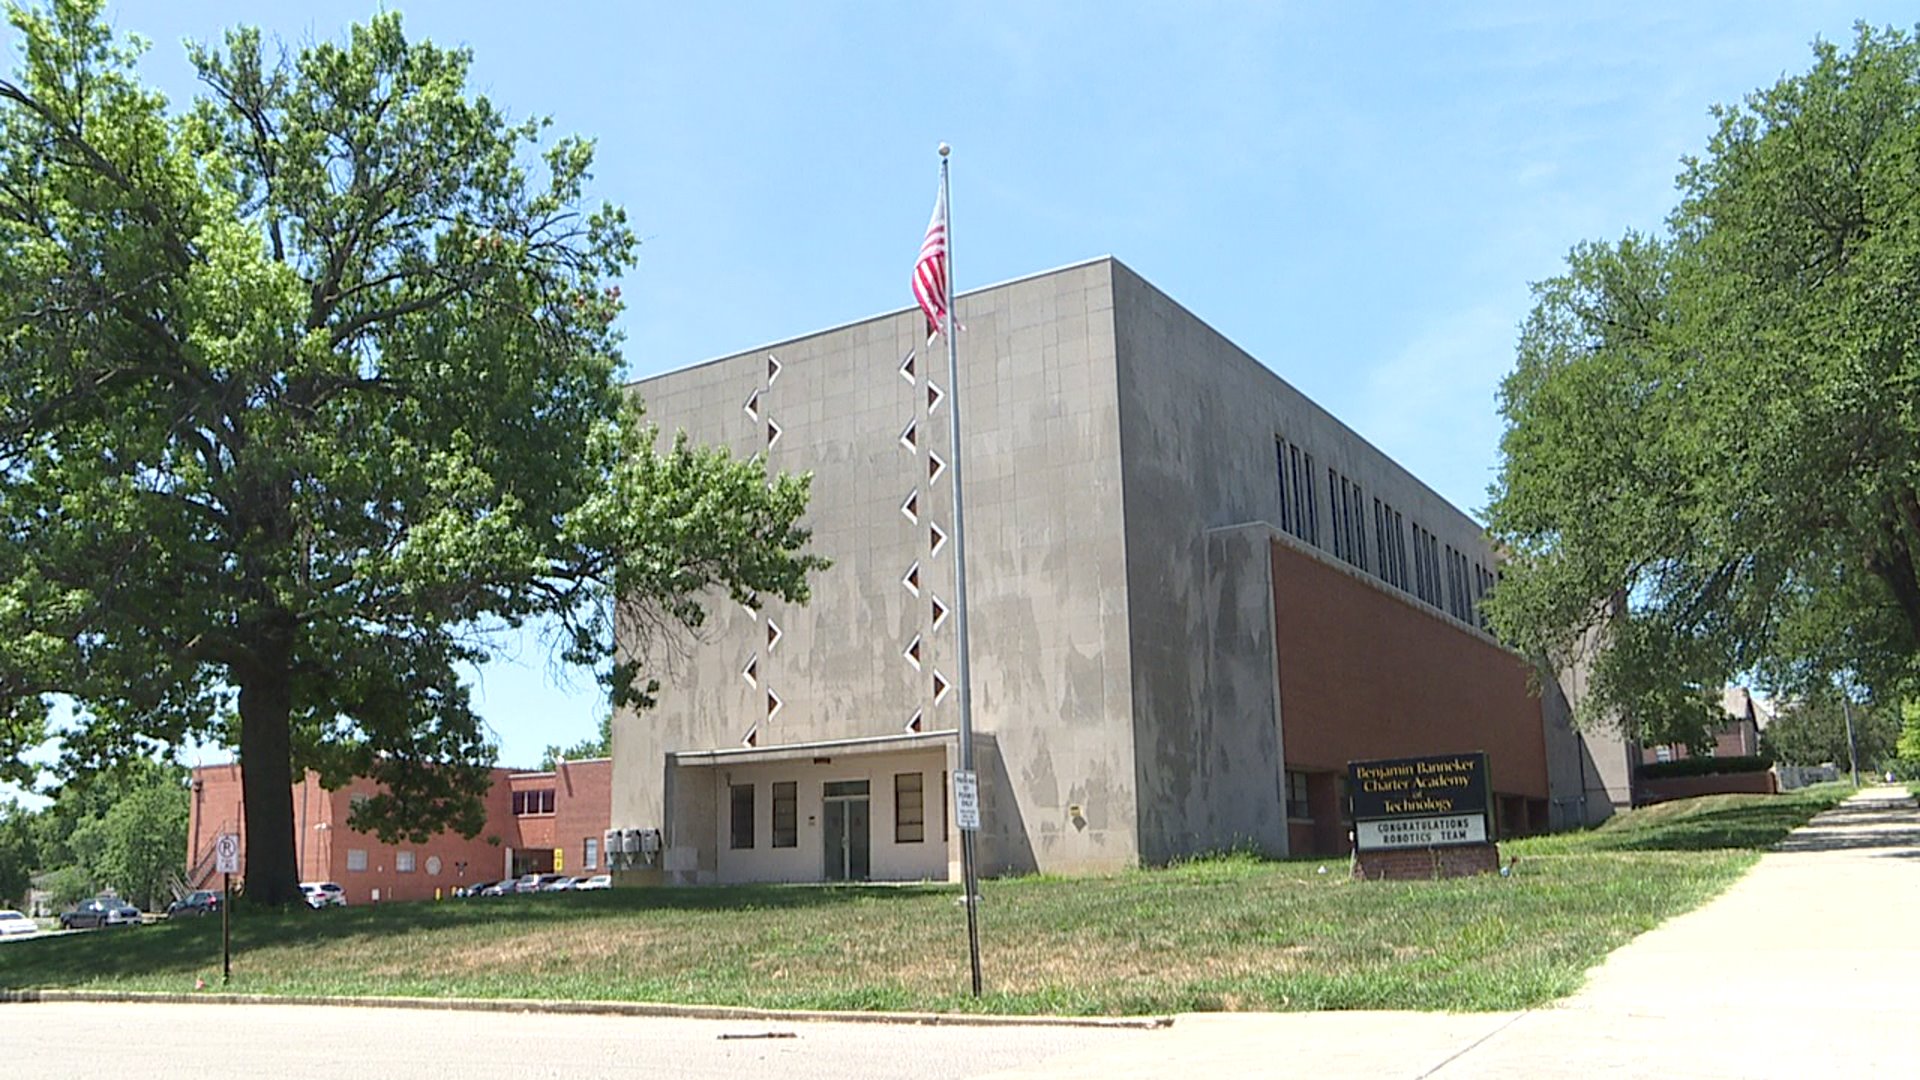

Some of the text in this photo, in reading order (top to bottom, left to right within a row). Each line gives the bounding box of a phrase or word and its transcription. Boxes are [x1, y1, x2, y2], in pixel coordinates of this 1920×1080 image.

[1357, 759, 1475, 780] Benjamin Banneker
[1364, 775, 1470, 792] Charter Academy
[1413, 790, 1423, 798] of
[1385, 798, 1453, 813] Technology
[1378, 818, 1469, 832] CONGRATULATIONS
[1384, 830, 1467, 843] ROBOTICS TEAM
